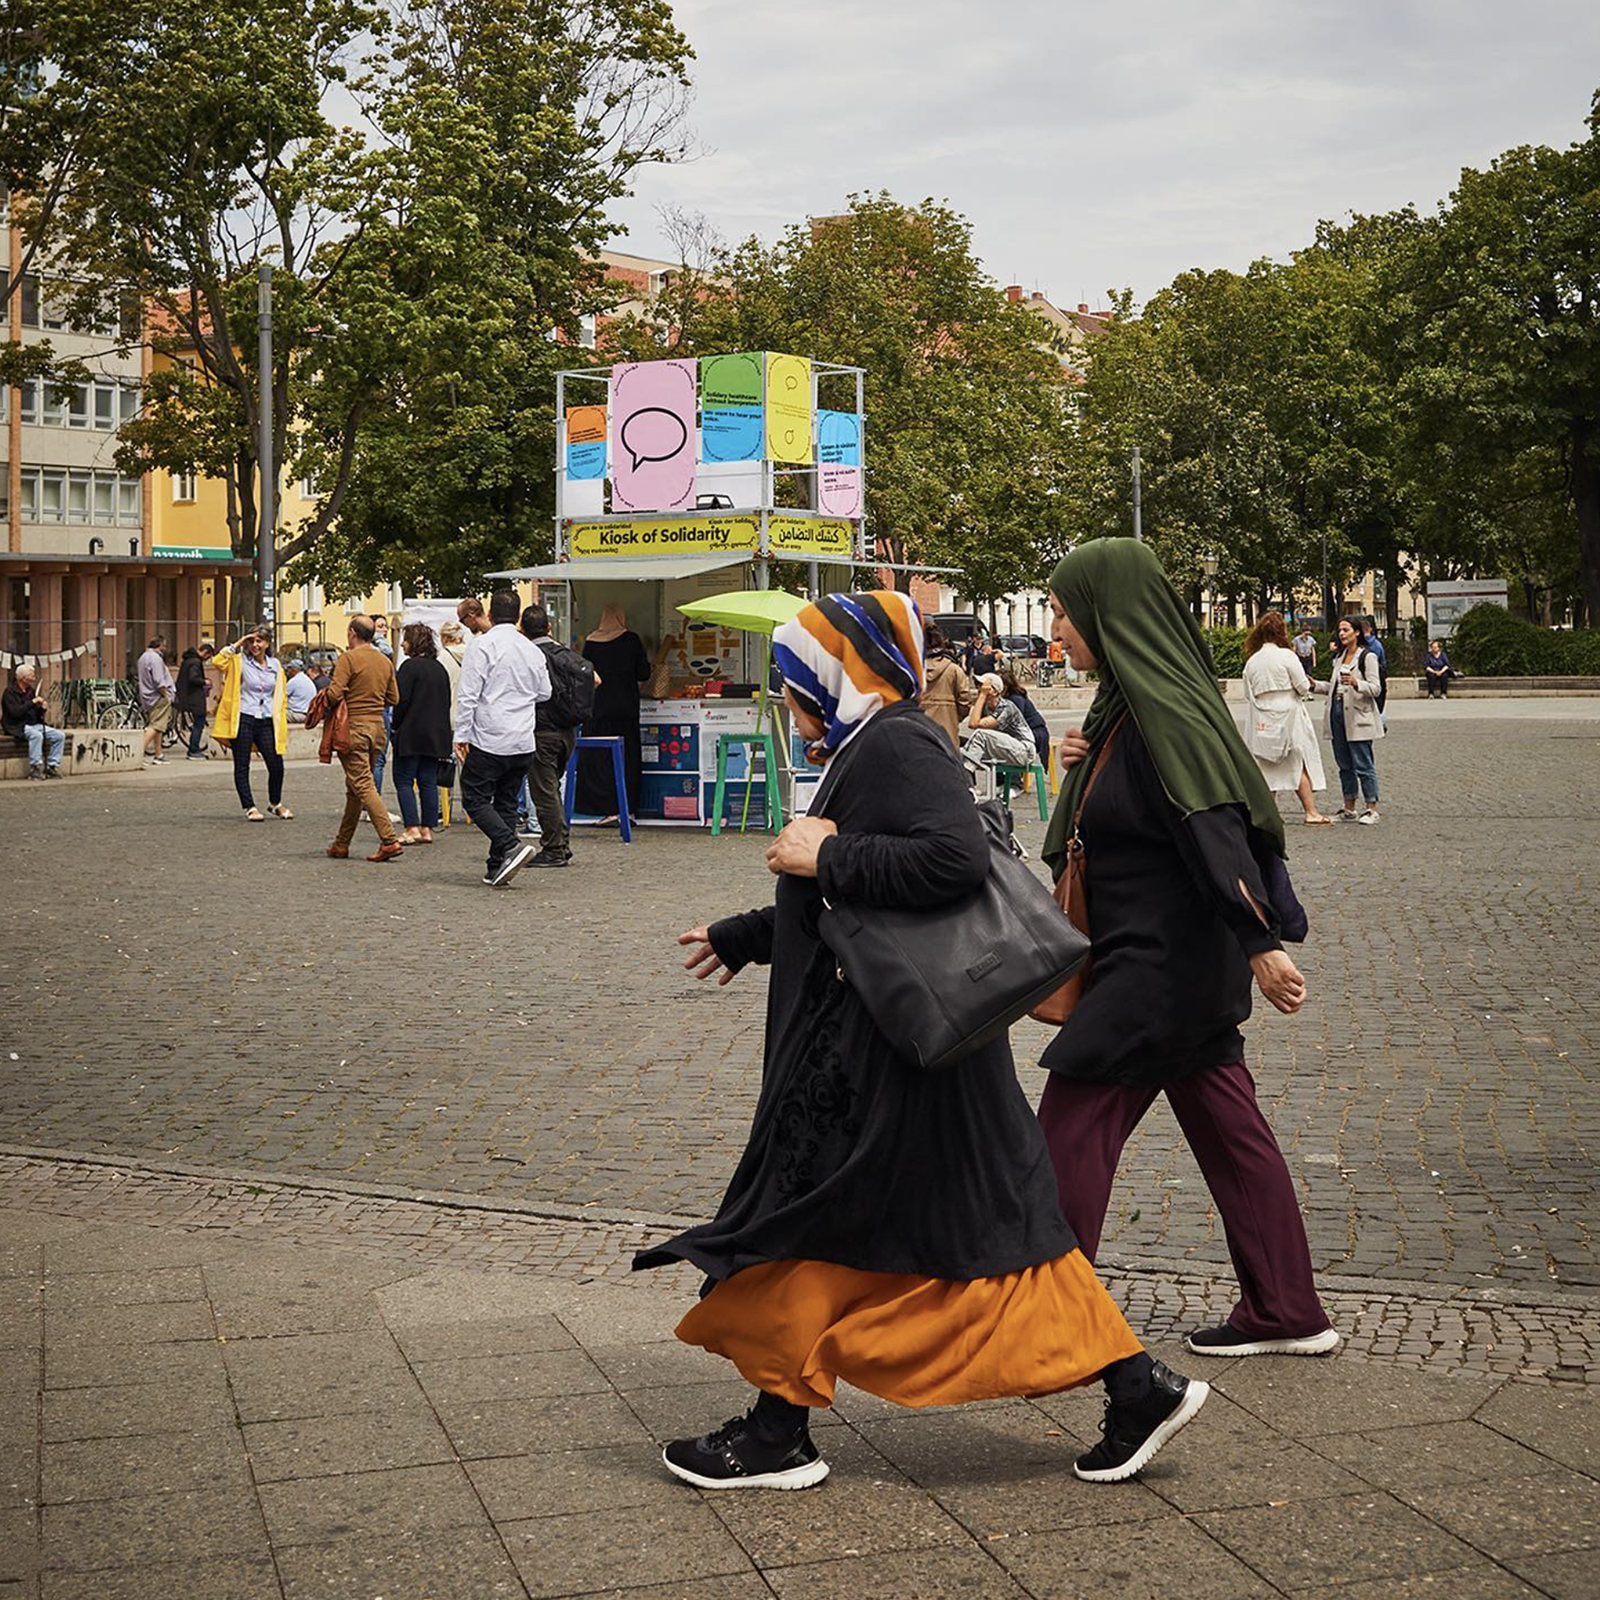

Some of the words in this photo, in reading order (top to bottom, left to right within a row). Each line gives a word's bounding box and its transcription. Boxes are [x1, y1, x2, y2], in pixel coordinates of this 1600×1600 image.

[600, 530, 639, 545] Kiosk
[642, 529, 658, 543] of
[660, 525, 730, 543] Solidarity
[778, 527, 814, 543] التضامن
